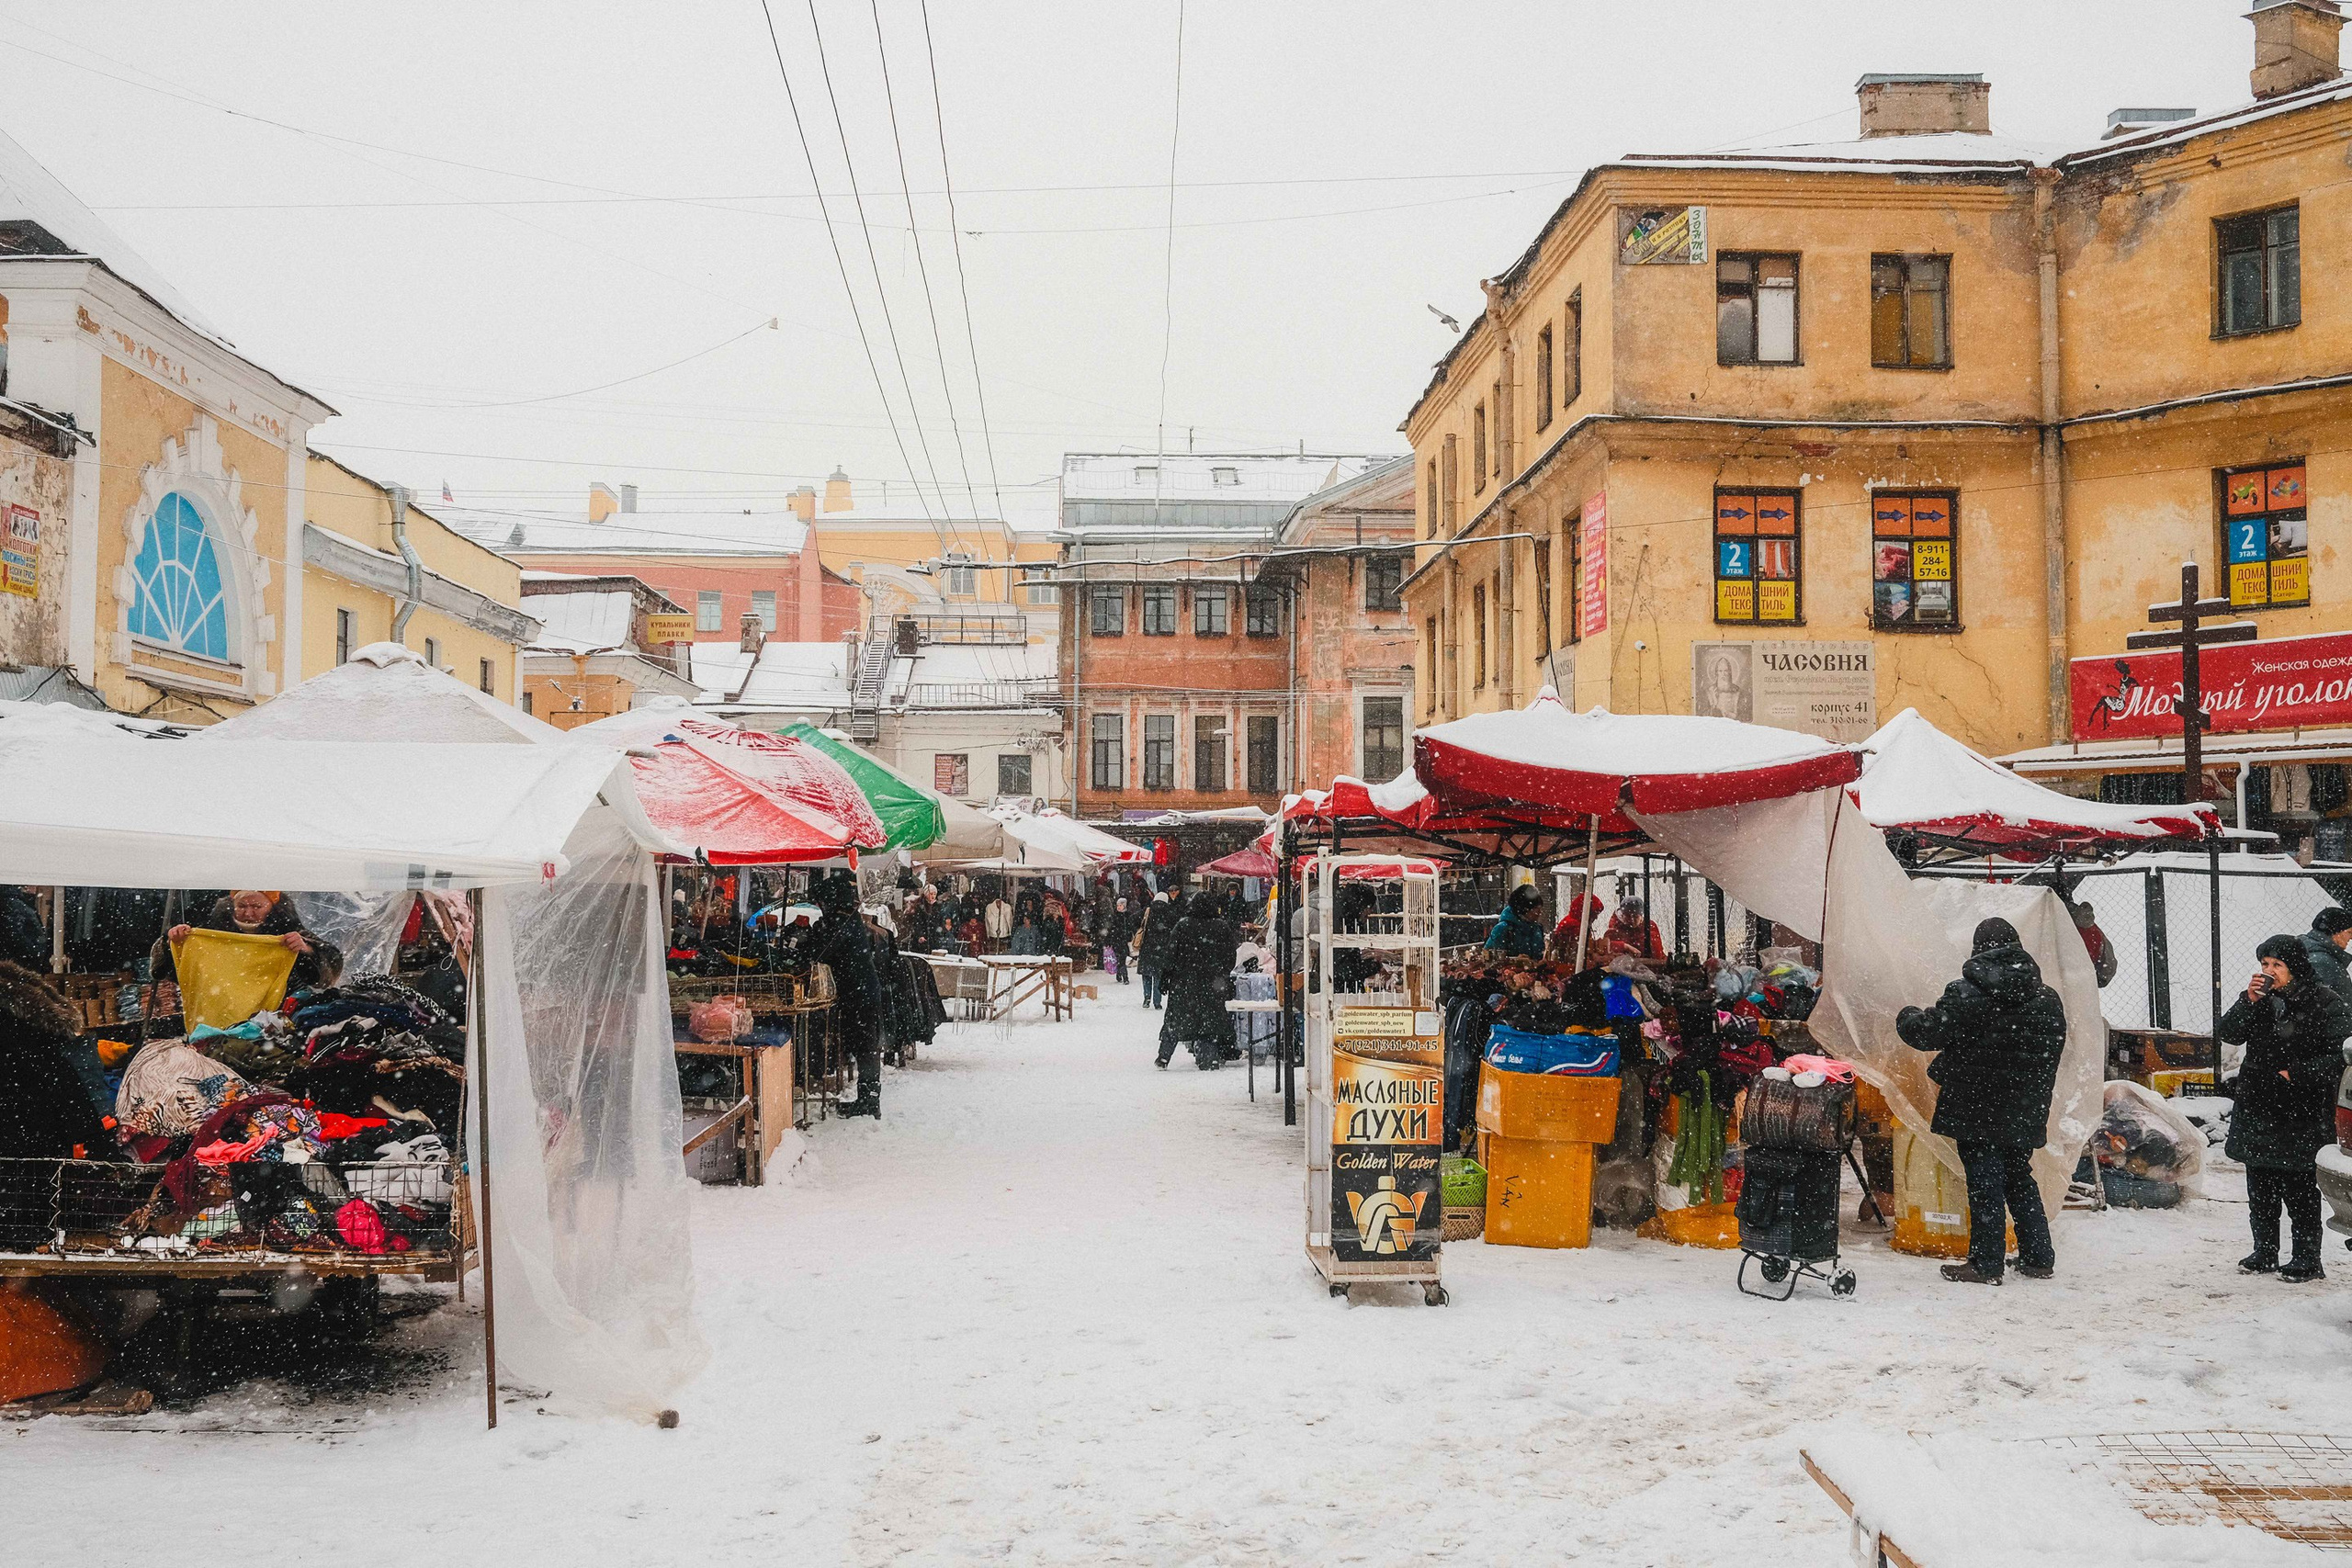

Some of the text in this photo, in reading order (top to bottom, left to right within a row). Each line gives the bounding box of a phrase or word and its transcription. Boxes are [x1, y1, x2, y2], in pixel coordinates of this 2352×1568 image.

[2242, 525, 2255, 549] 2
[1728, 544, 1741, 567] 2
[1917, 545, 1949, 554] 8-911-
[2238, 550, 2257, 558] этаж
[1922, 557, 1944, 565] 284-
[1919, 568, 1948, 577] 57-16
[2236, 560, 2301, 582] ДОМА ШНИЙ
[1724, 583, 1789, 598] ДОМА ШНИЙ
[2243, 578, 2299, 593] ТЕКС ТИЛЬ
[1730, 599, 1786, 611] ТЕКС ТИЛЬ
[1762, 654, 1869, 671] ЧАСОВНЯ
[2252, 660, 2310, 674] Женская
[2110, 678, 2246, 721] Модый
[1811, 701, 1868, 716] корпус 41
[1338, 1039, 1439, 1053] +7(921)341-91-45
[1337, 1078, 1439, 1105] МАСЛЯНЫЕ
[1346, 1108, 1429, 1142] ДУХИ
[1336, 1152, 1439, 1169] Golden Water
